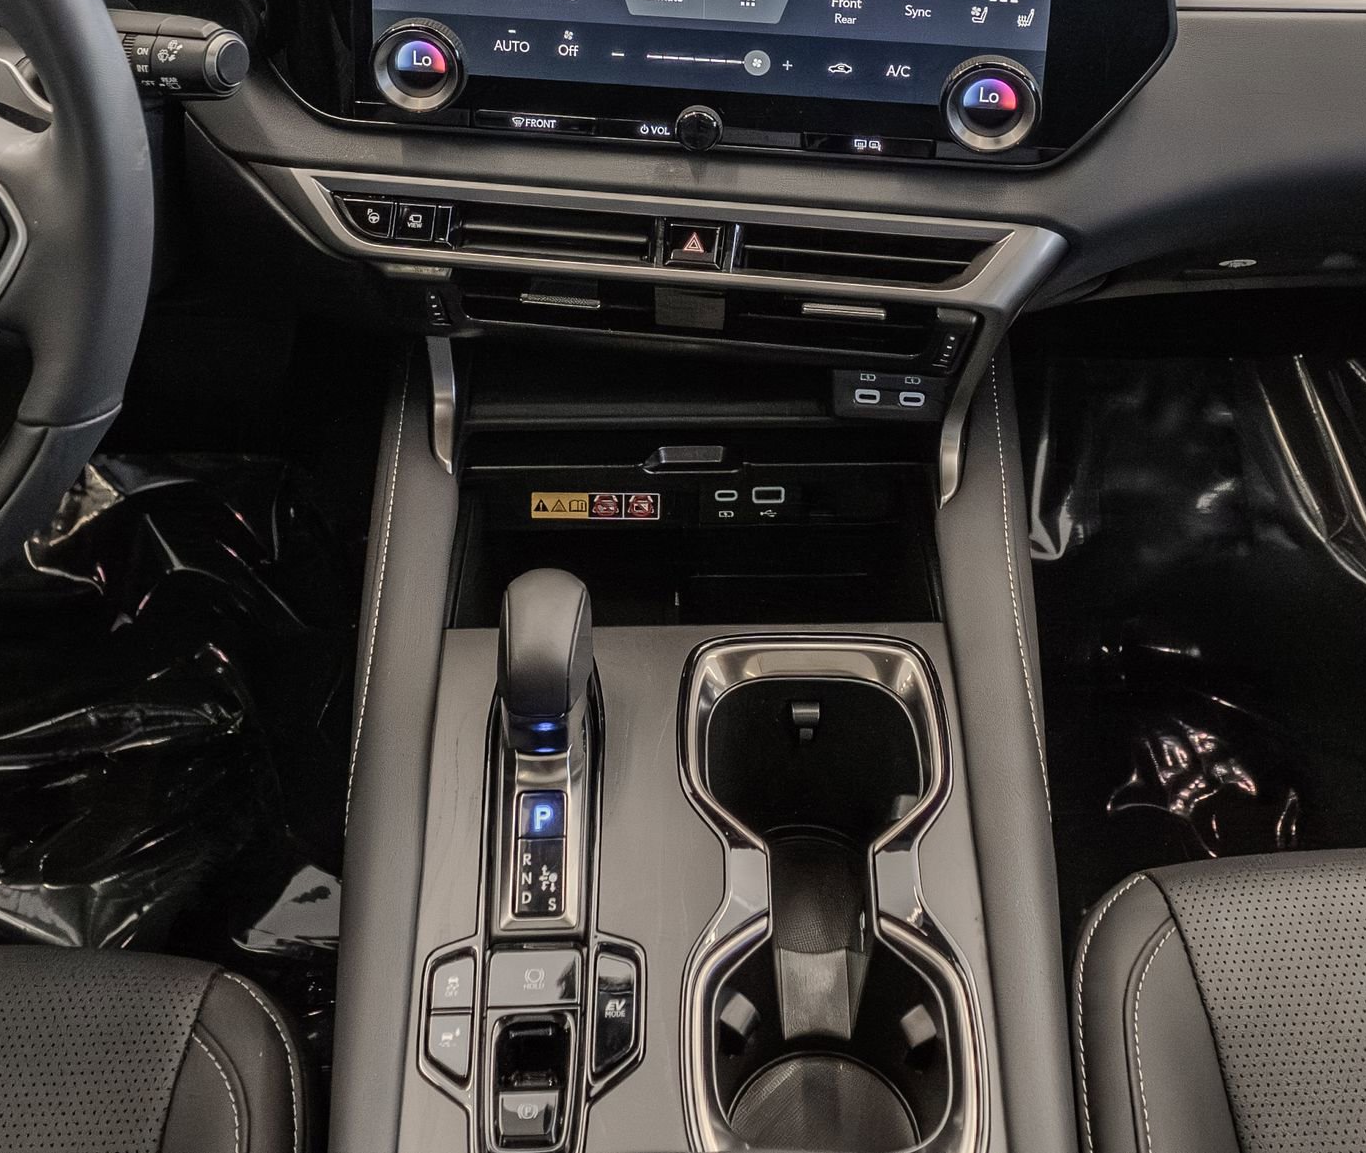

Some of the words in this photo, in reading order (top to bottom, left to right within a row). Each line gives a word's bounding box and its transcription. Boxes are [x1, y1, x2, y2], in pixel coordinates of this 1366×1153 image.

[905, 5, 932, 19] Sync
[835, 13, 857, 25] Rear
[493, 40, 530, 53] AUTO
[558, 45, 579, 57] Off
[412, 50, 432, 67] Lo
[136, 64, 149, 72] INT
[886, 65, 911, 78] A/C
[979, 87, 999, 104] Lo
[525, 119, 557, 129] FRONT
[651, 126, 670, 136] VOL
[534, 804, 554, 832] P
[523, 853, 532, 866] R
[521, 872, 532, 885] N
[522, 891, 532, 905] D
[548, 898, 557, 911] S
[523, 982, 545, 991] HOLD
[606, 999, 626, 1010] EV
[604, 1010, 626, 1018] MODE
